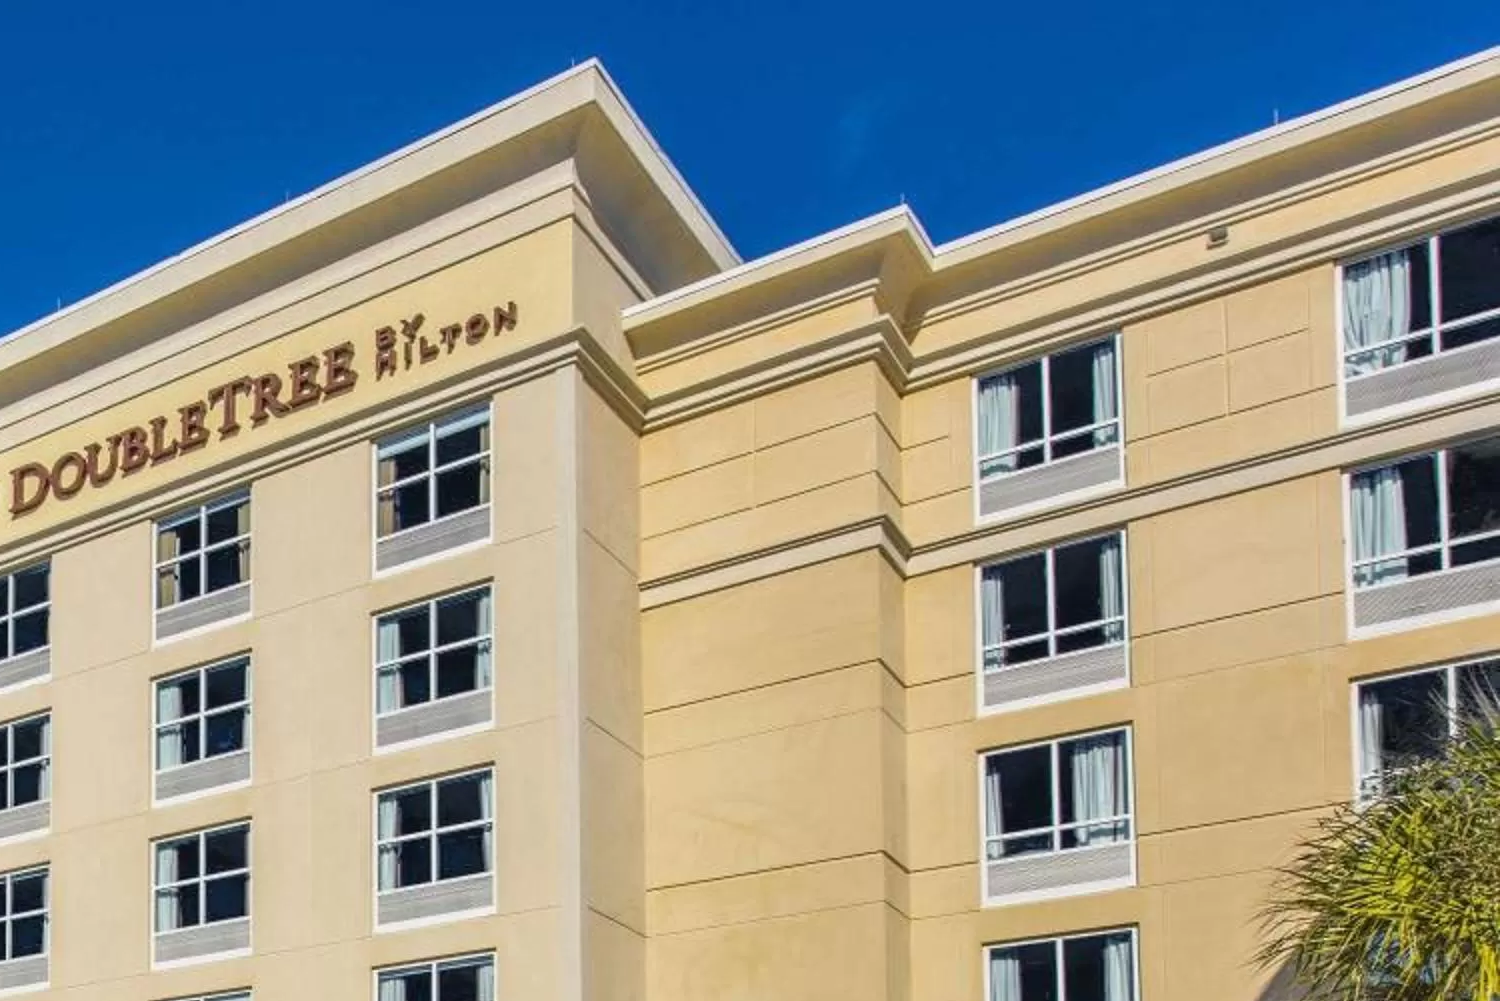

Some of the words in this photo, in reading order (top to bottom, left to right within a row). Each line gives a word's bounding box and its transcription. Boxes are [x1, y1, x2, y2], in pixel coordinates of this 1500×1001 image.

[375, 312, 426, 351] BY
[375, 301, 517, 382] HILTON
[8, 340, 359, 520] DOUBLETREE
